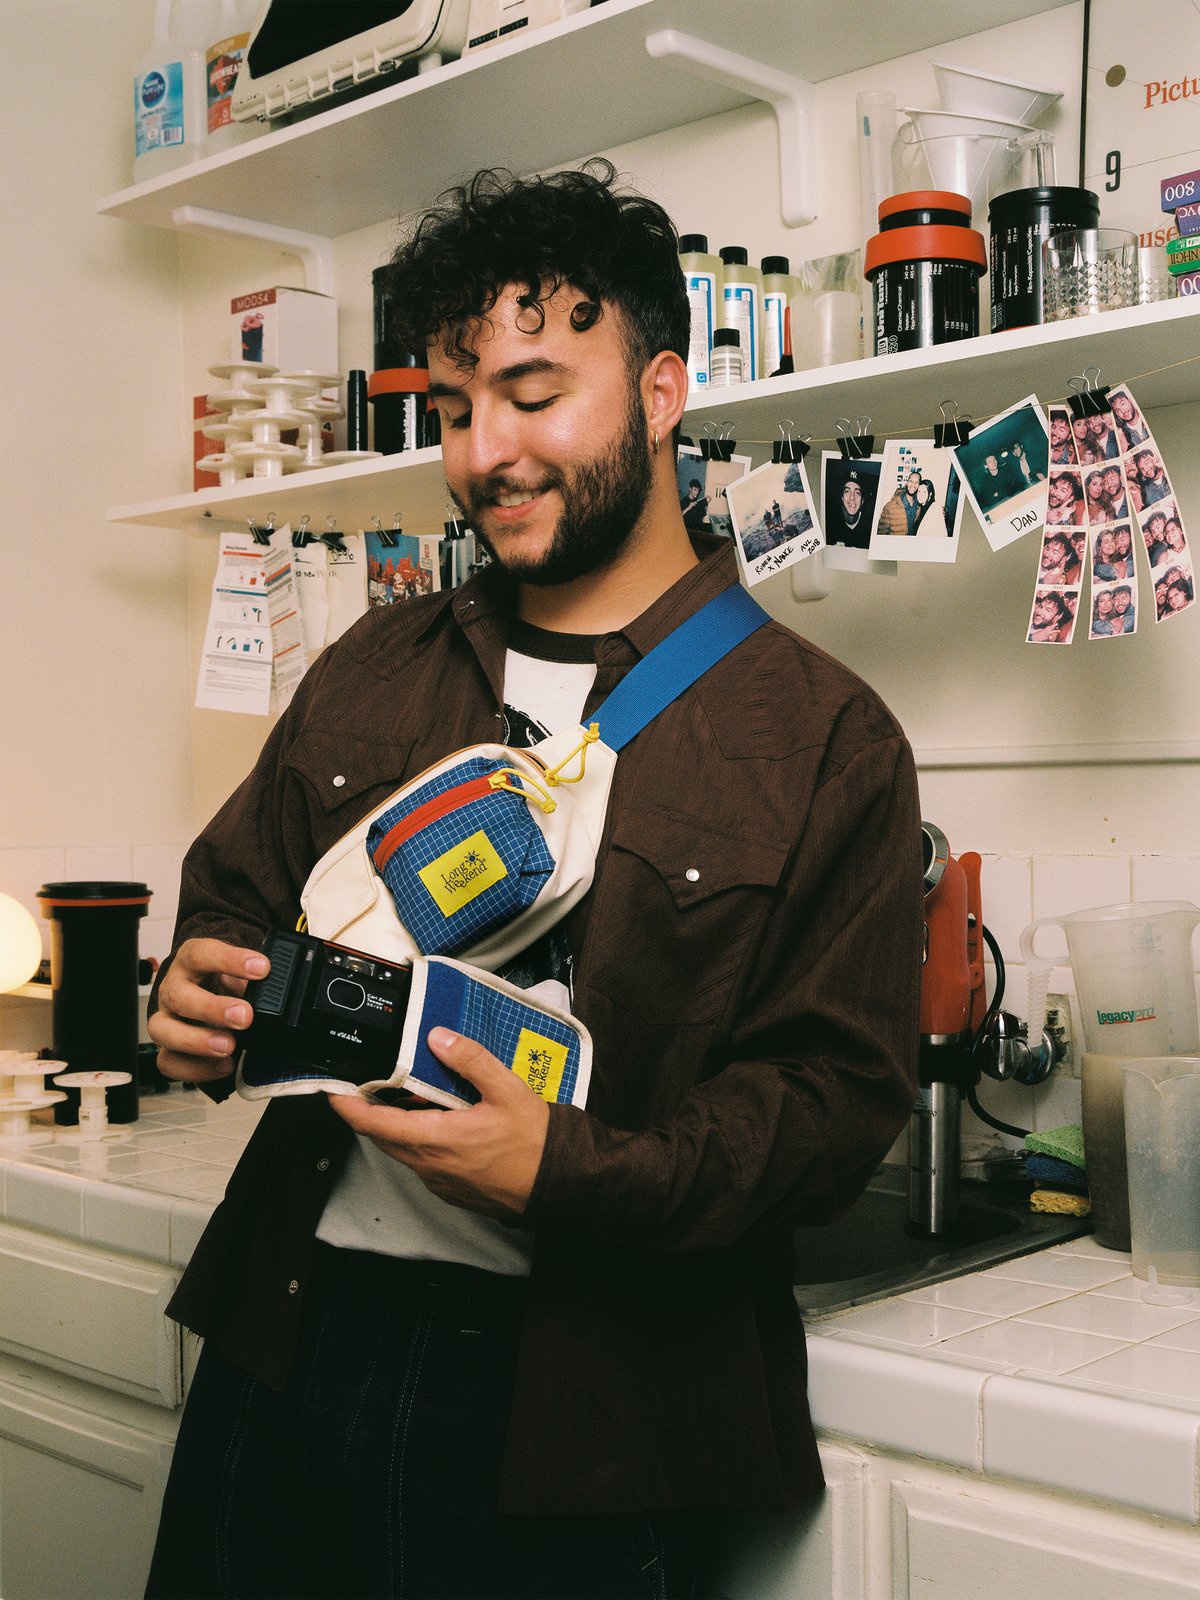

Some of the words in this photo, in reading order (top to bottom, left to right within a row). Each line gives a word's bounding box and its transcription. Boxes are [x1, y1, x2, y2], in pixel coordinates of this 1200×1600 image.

[1105, 150, 1121, 192] 9
[1165, 181, 1195, 202] 800
[1139, 227, 1178, 248] use
[877, 271, 885, 337] UniTank
[1010, 510, 1037, 532] DAN
[807, 538, 821, 554] 2018
[440, 862, 469, 885] Long
[444, 860, 488, 894] Weekend
[527, 1065, 540, 1090] ong
